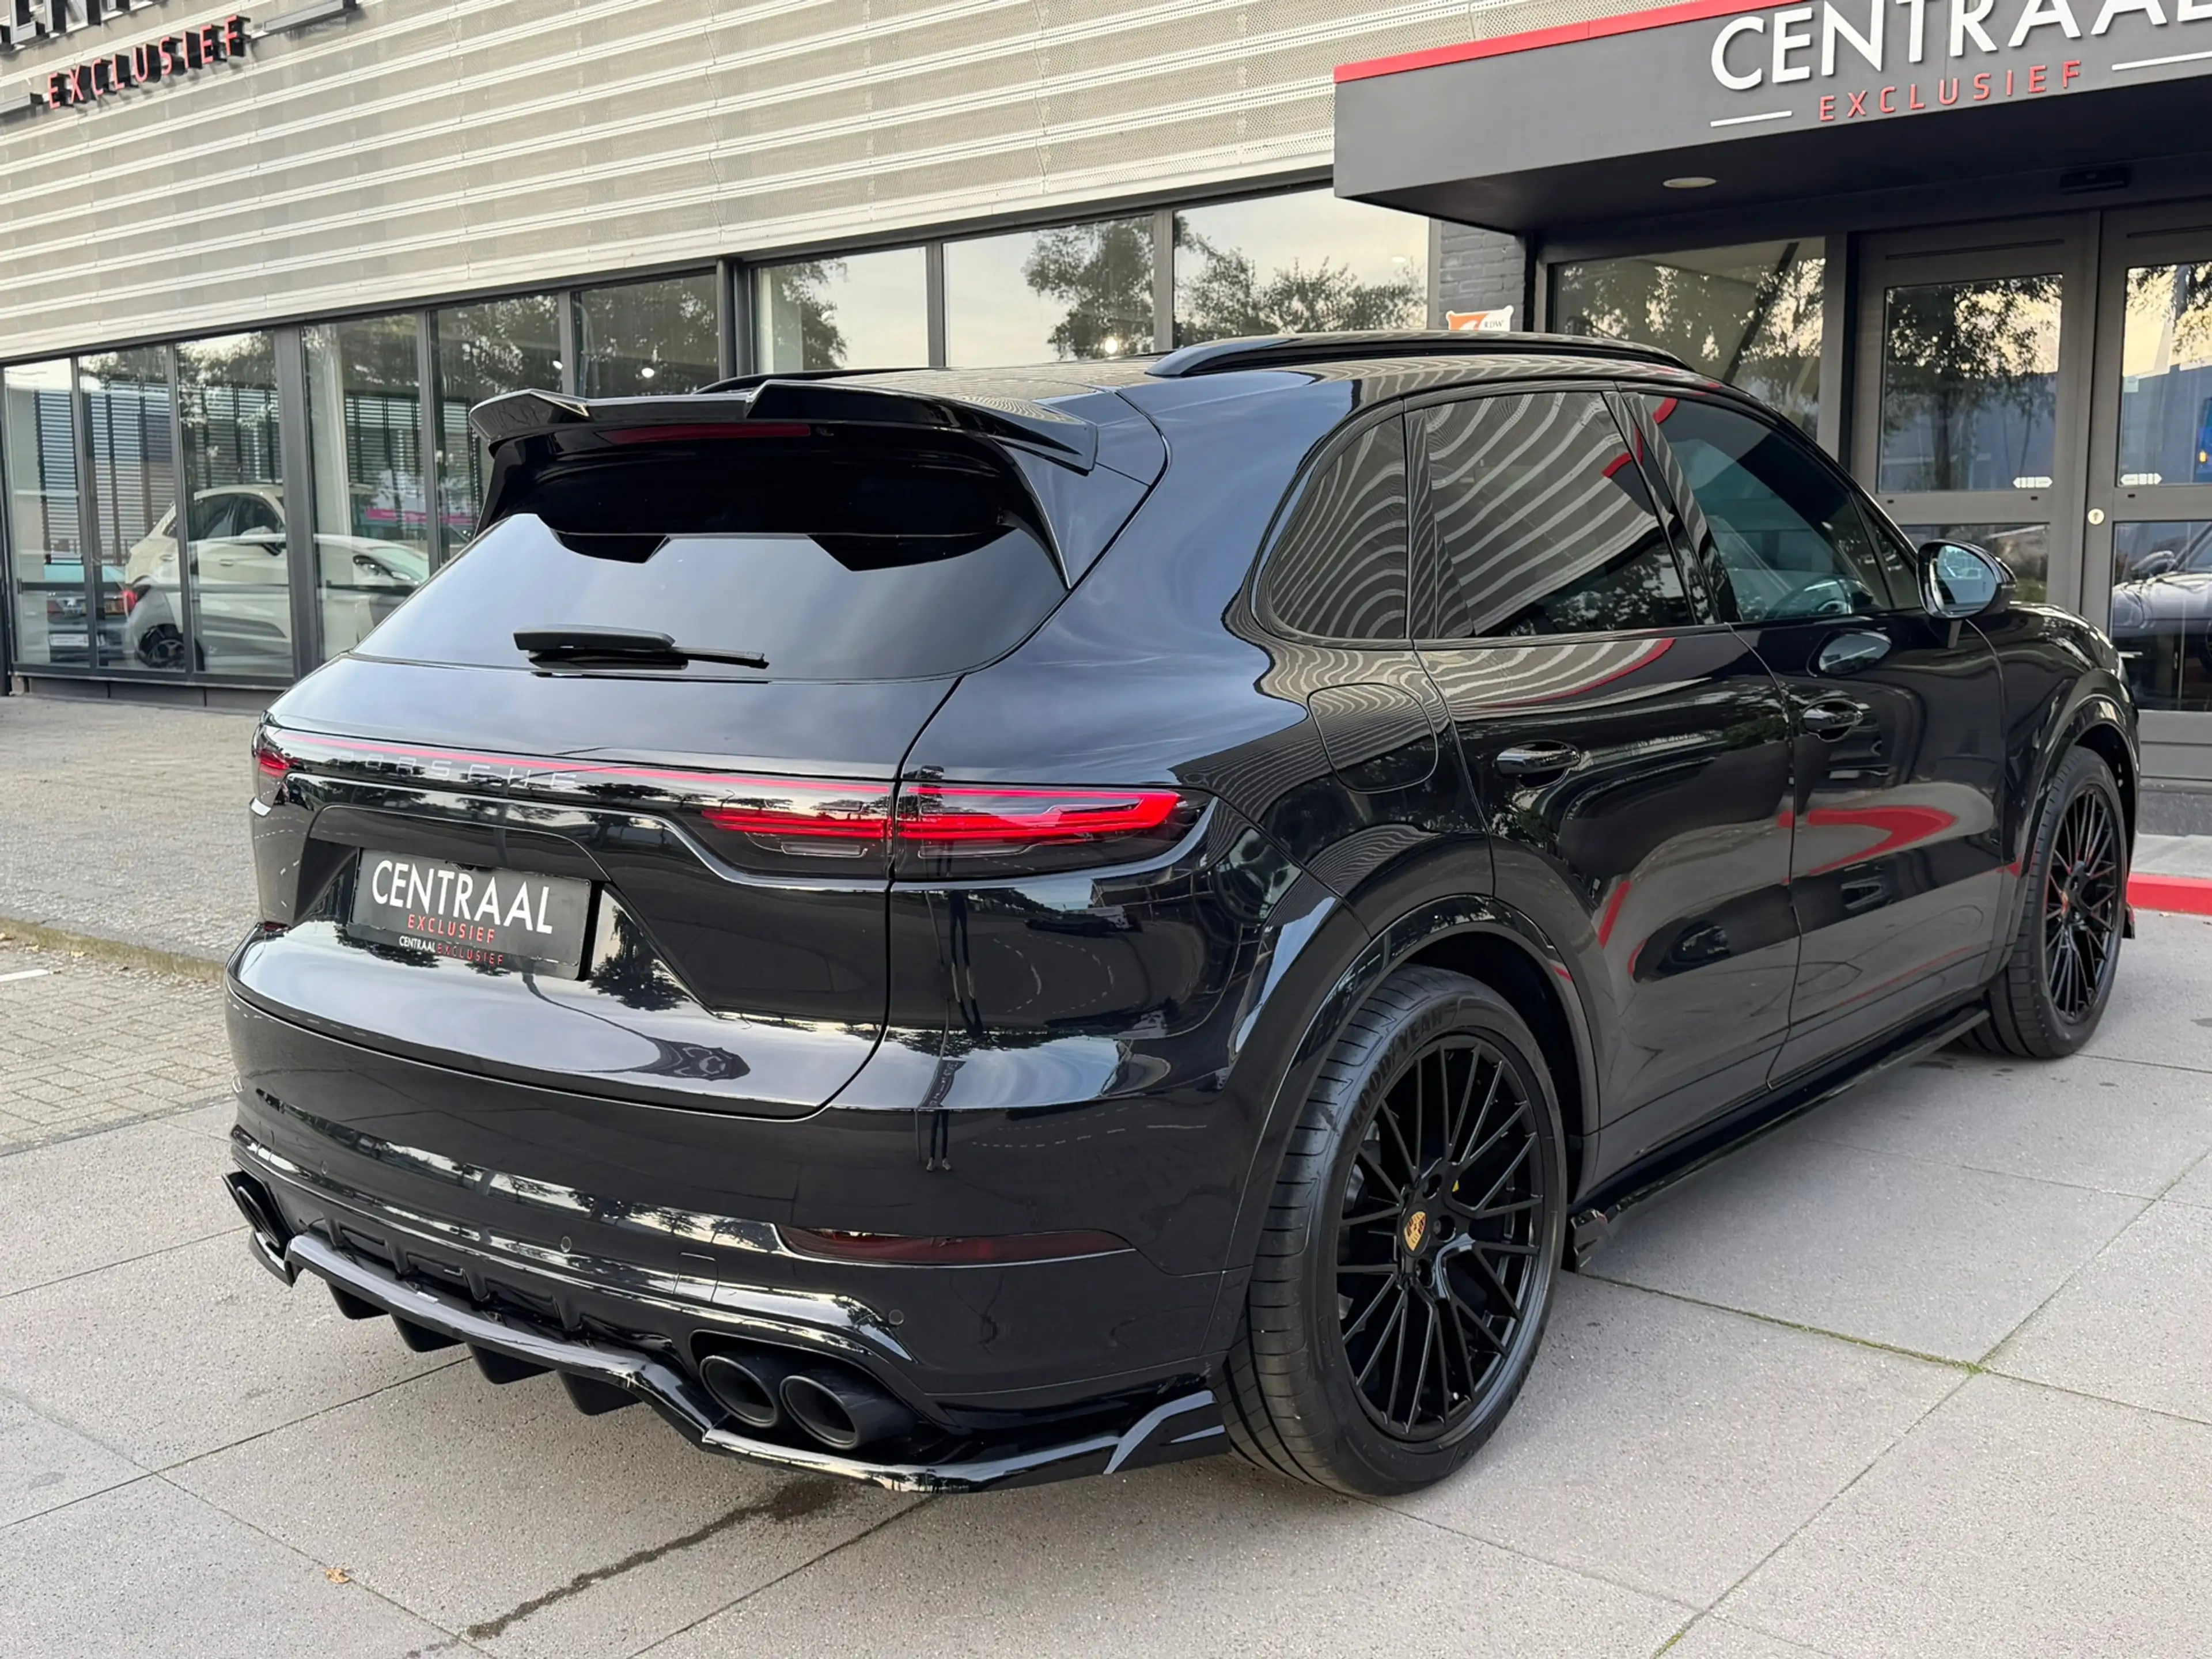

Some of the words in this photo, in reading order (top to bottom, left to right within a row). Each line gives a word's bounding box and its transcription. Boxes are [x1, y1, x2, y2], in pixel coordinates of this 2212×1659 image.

[47, 15, 240, 110] EXCLUSIEF
[1819, 59, 2081, 122] EXCLUSIEF
[338, 750, 577, 790] PORSCHE
[372, 859, 553, 934] CENTRAAL
[399, 935, 436, 953] CENTRAAL
[437, 943, 503, 966] EXCLUSIEF
[407, 914, 495, 944] EXCLUSIEF
